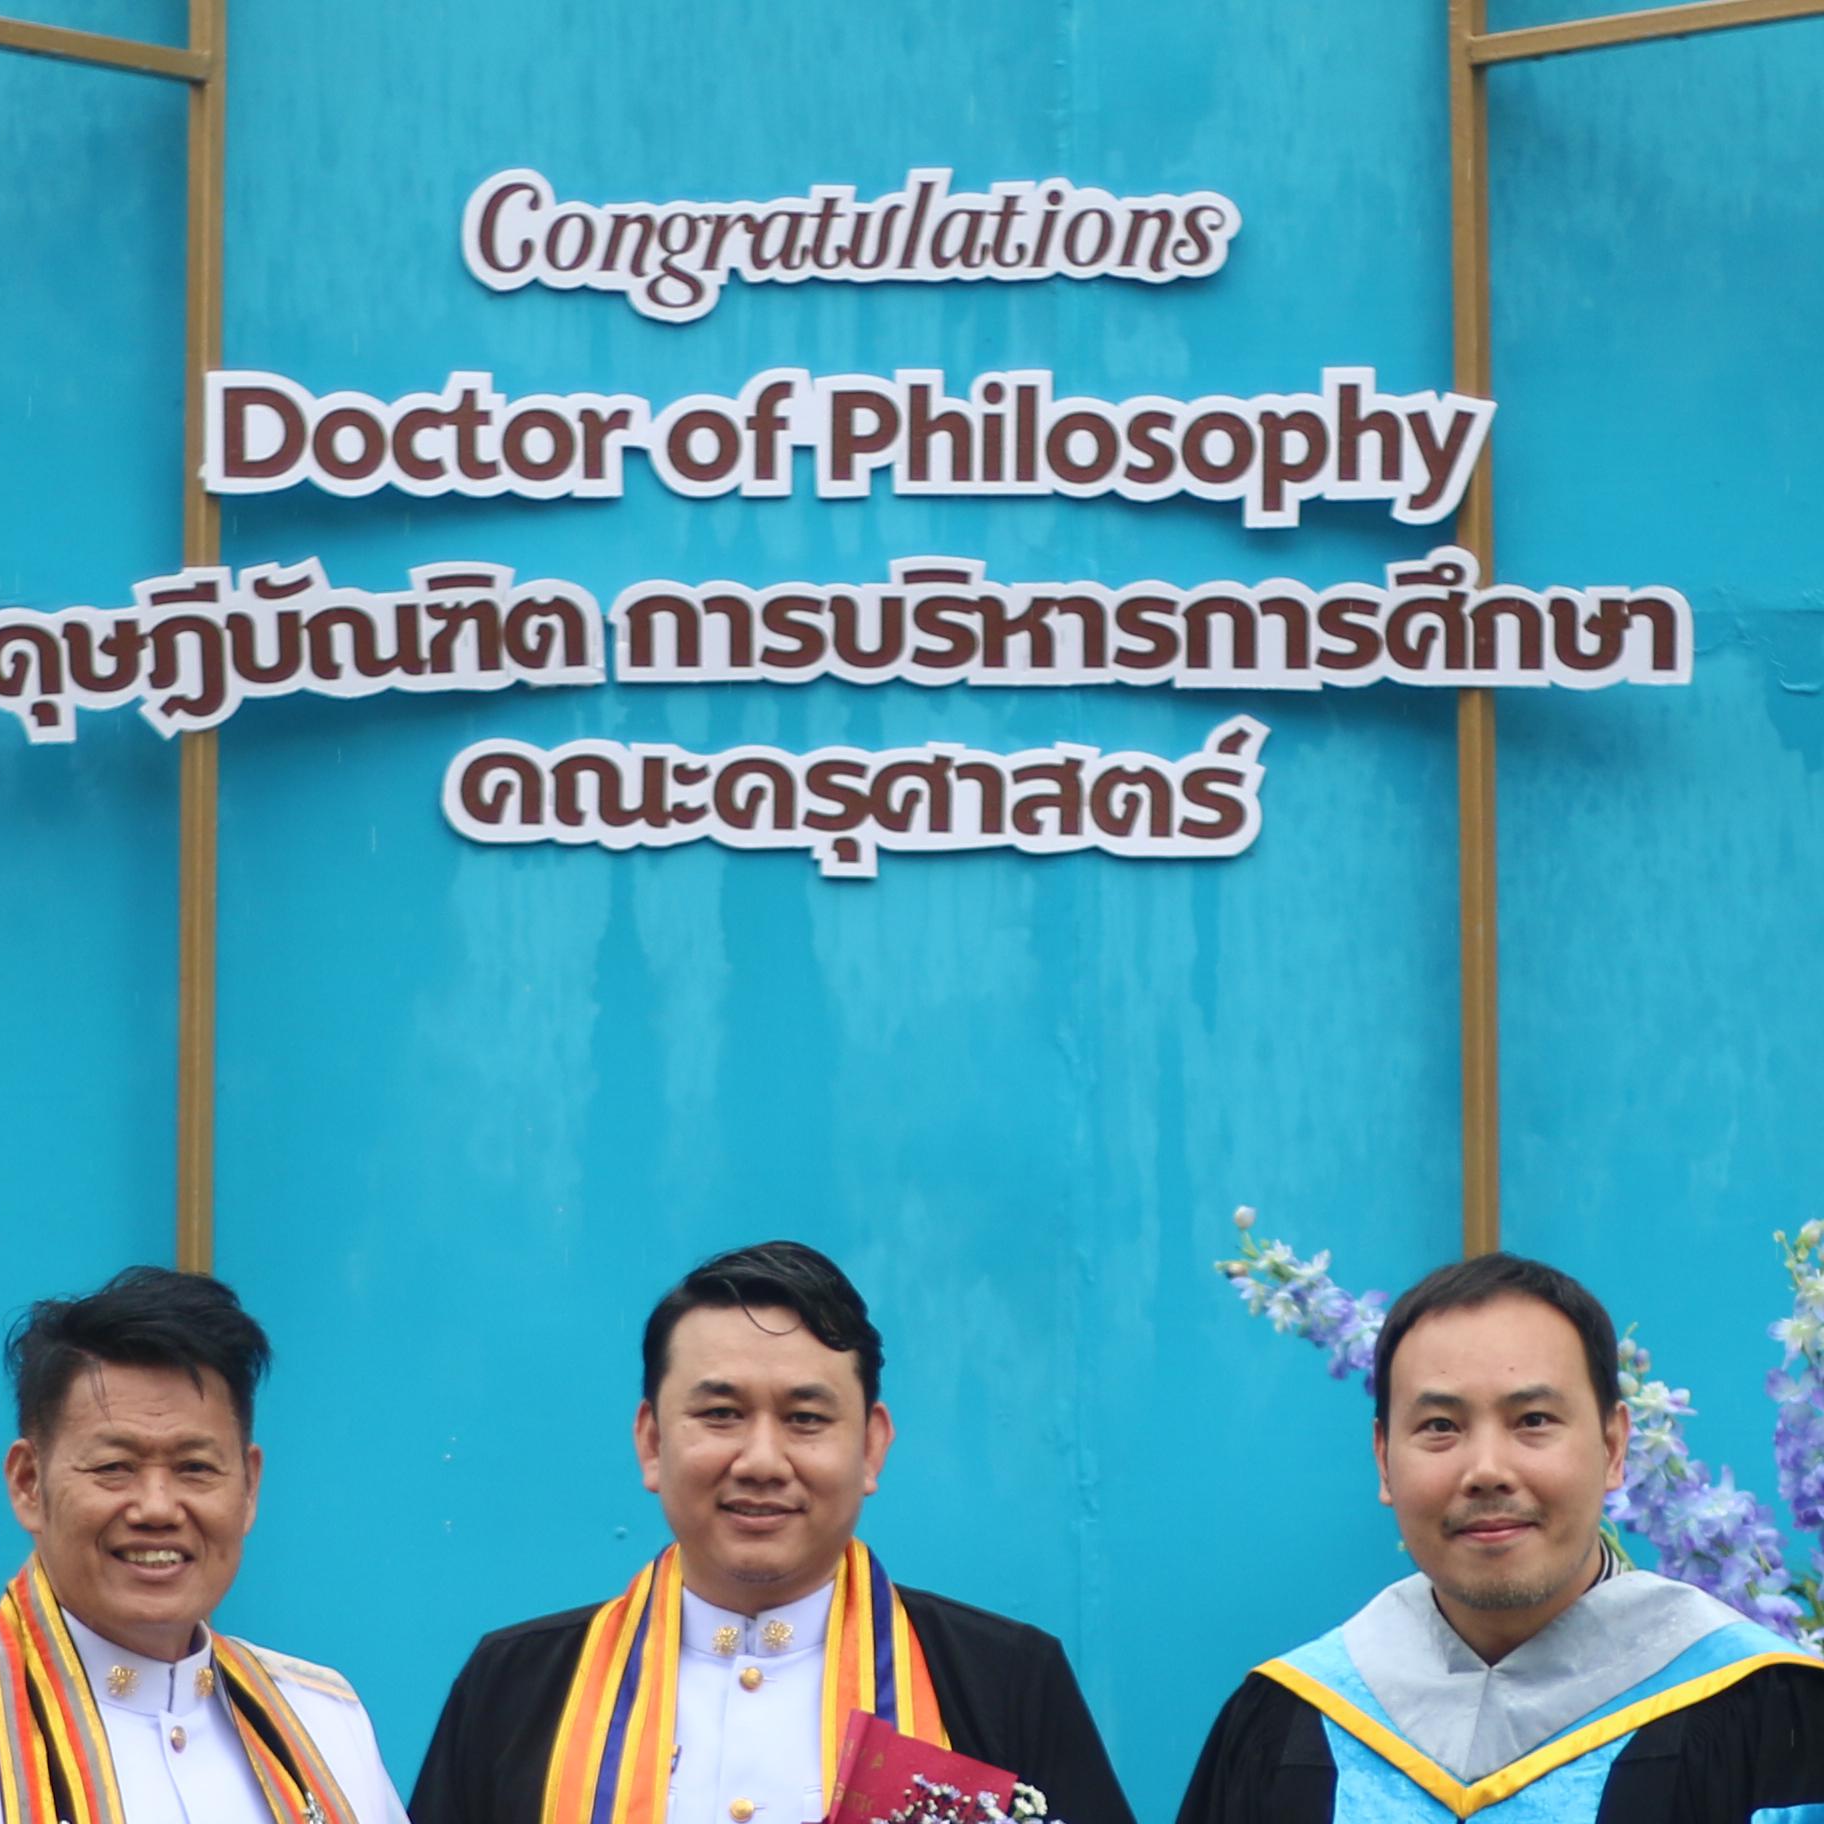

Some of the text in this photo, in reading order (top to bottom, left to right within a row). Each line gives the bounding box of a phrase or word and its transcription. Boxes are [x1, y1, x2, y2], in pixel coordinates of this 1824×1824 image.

[477, 180, 1226, 308] Congratulations
[221, 383, 1474, 513] Doctor of Philosophy
[624, 562, 1677, 672] การบริหารการศึกษา
[460, 729, 1249, 863] คณะครุศาสตร์
